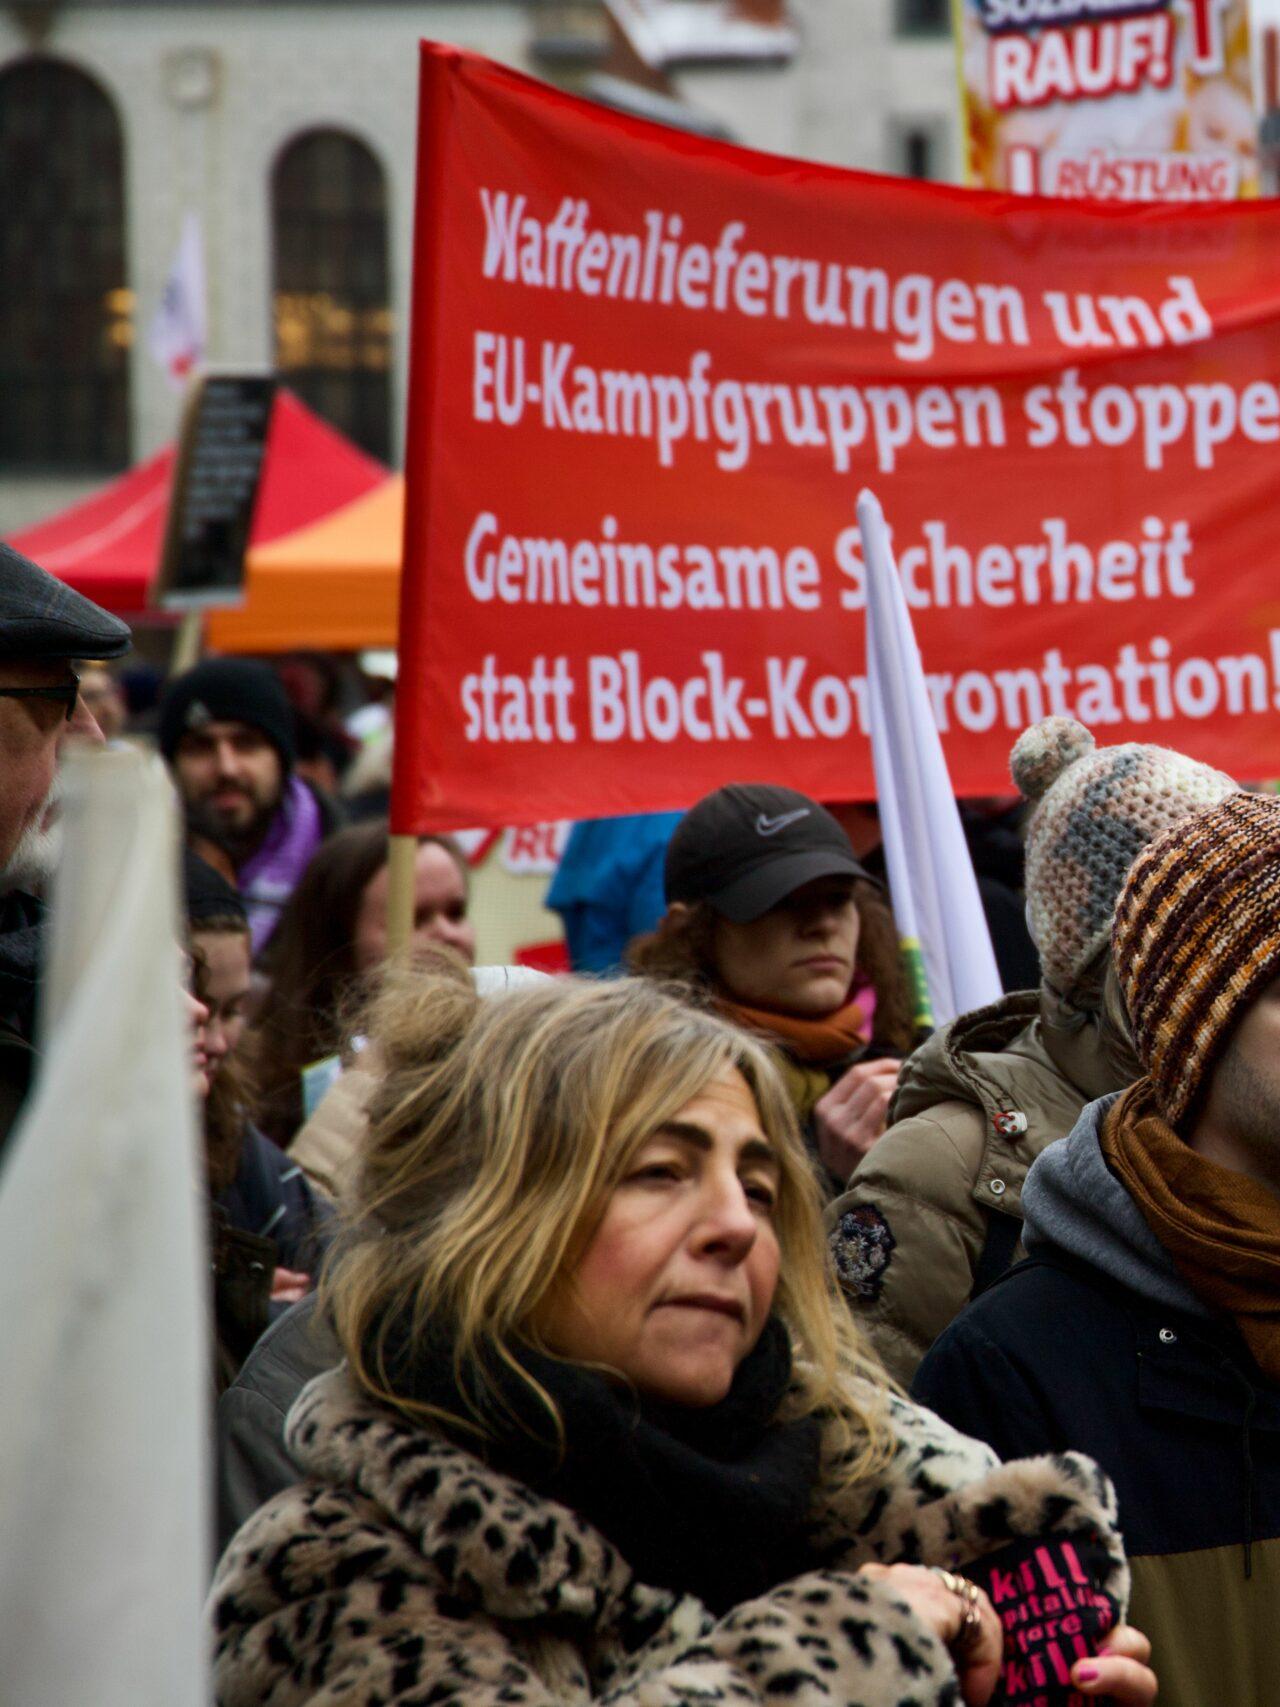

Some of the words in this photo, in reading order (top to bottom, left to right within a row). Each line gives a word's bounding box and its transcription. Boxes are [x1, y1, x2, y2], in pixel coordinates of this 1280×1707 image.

[993, 14, 1168, 105] RAUF!
[1055, 151, 1231, 197] RÜSTUNG
[480, 188, 1029, 362] Waffenlieferungen
[1043, 276, 1212, 348] und
[474, 332, 1005, 473] EU-Kampfgruppen
[465, 512, 821, 610] Gemeinsame
[835, 516, 1194, 610] Scherheit
[461, 655, 575, 742] statt
